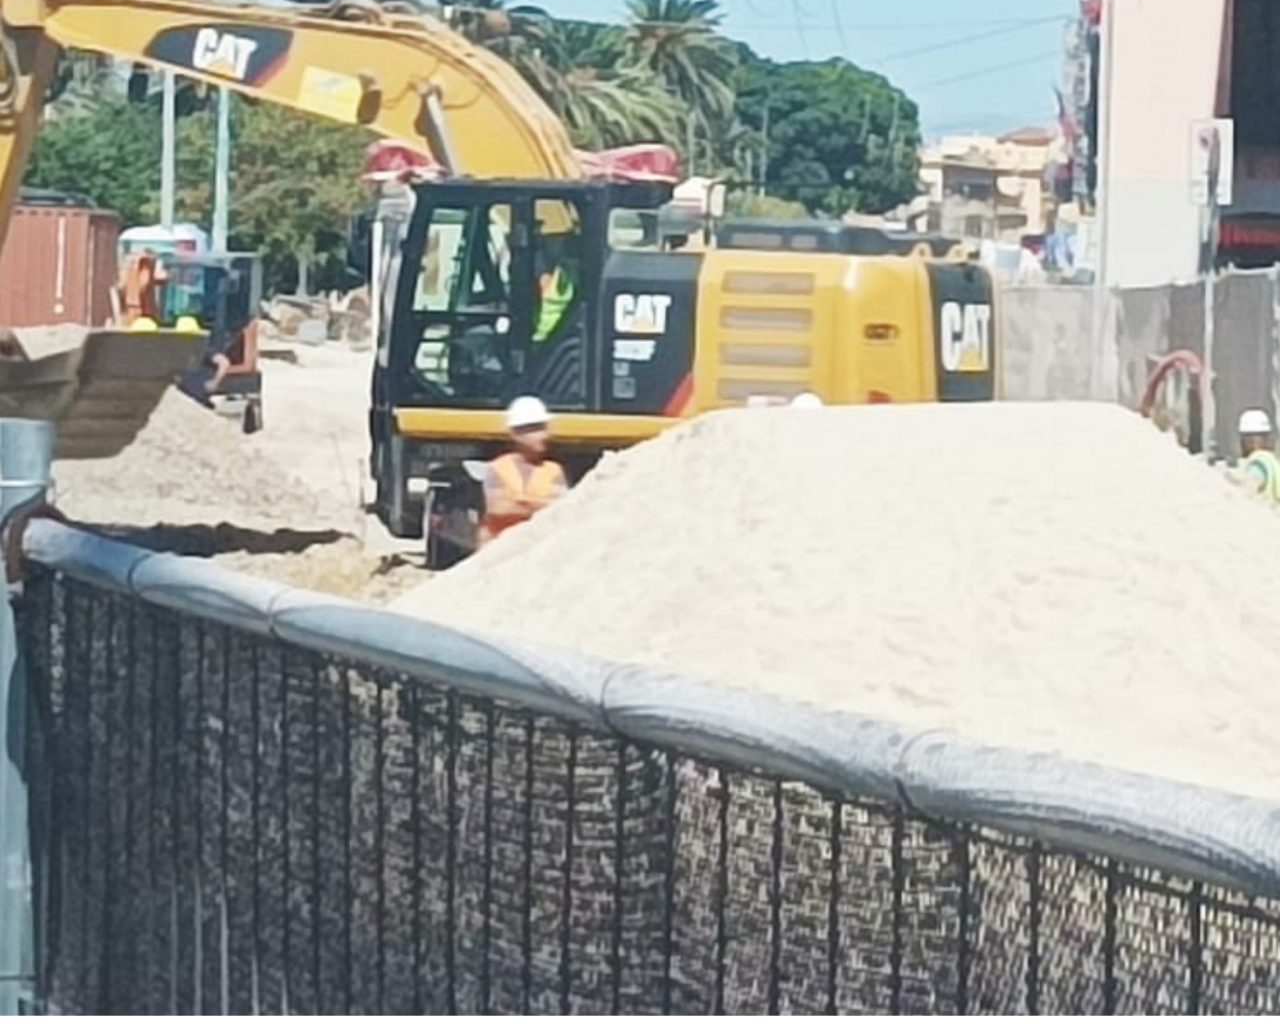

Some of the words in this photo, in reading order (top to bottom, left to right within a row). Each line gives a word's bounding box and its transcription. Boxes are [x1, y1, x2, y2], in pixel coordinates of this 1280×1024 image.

[193, 27, 258, 80] CAT
[615, 293, 672, 334] CAT
[940, 301, 992, 372] CAT
